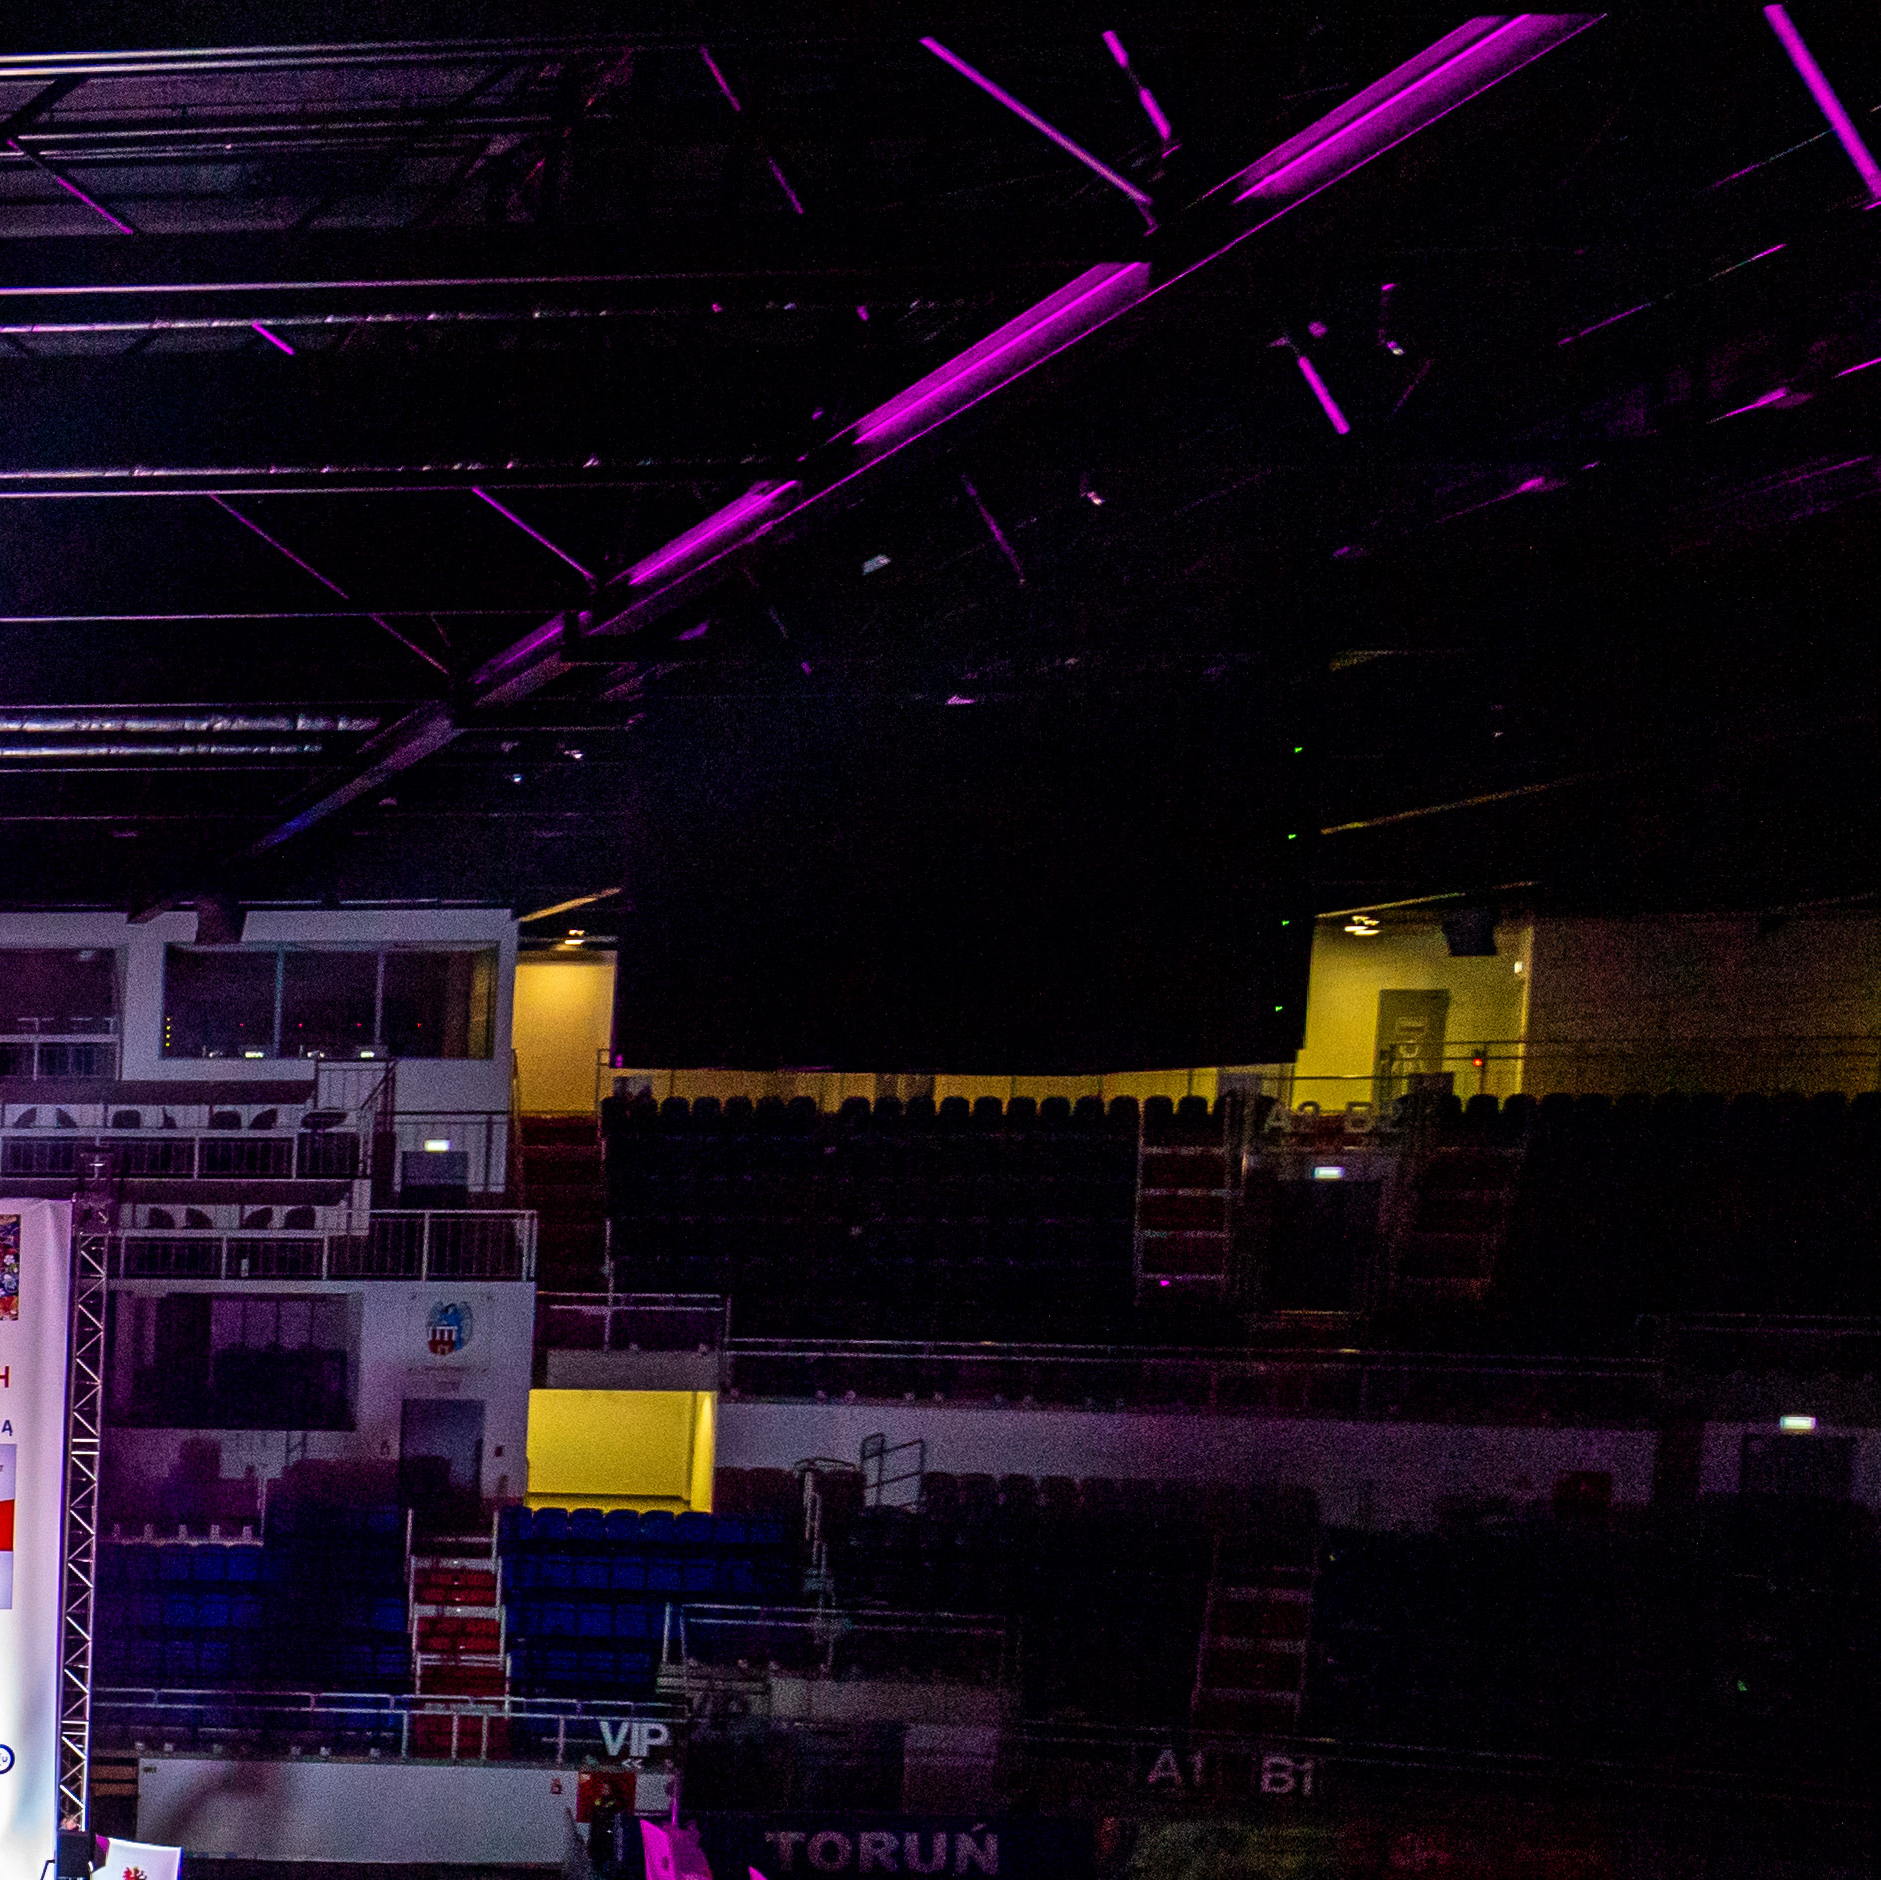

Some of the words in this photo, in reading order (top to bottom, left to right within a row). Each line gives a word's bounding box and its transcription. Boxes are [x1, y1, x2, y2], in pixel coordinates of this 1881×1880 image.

[599, 1721, 669, 1757] VIP
[1147, 1748, 1204, 1786] A1
[1260, 1755, 1315, 1796] B1
[764, 1823, 1000, 1875] TORUŃ
